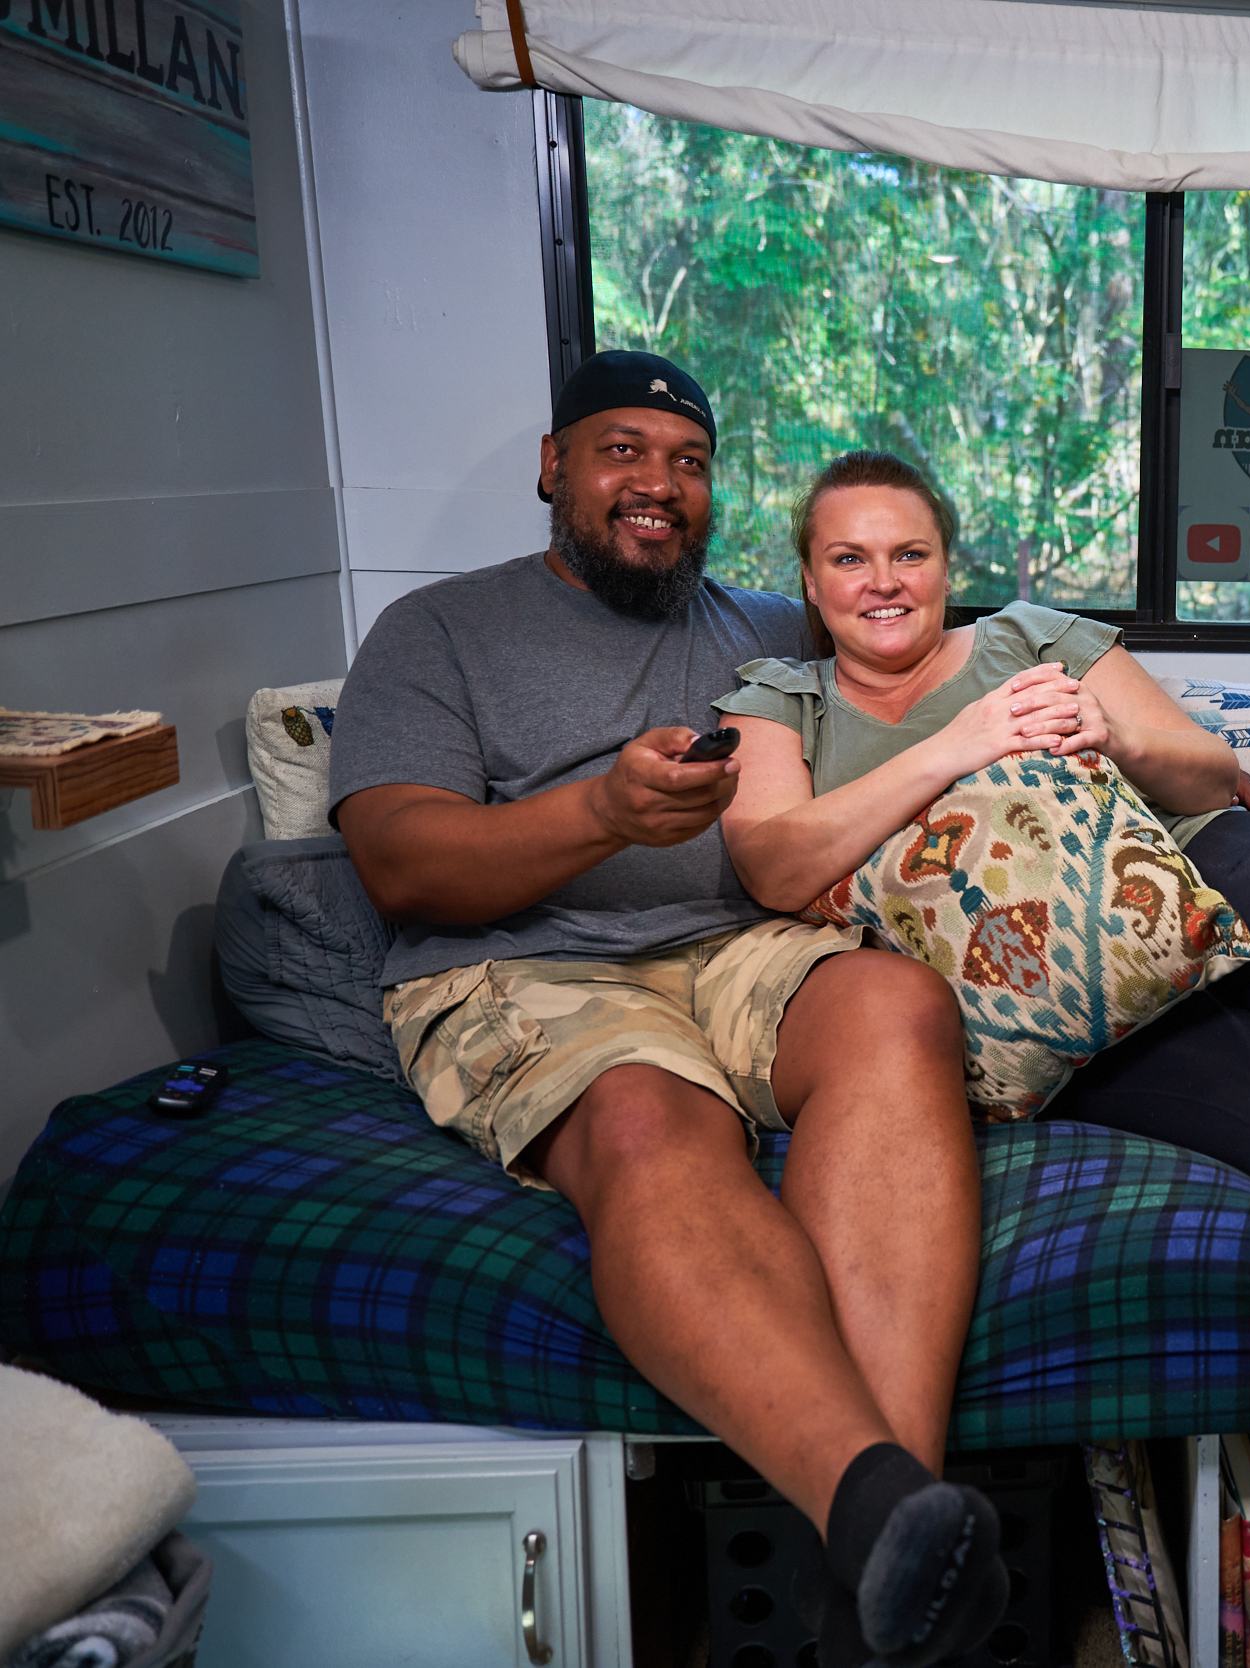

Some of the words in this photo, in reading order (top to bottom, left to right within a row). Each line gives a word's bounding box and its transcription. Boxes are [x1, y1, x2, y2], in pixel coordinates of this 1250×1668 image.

[0, 0, 245, 120] MILLAN
[46, 173, 102, 236] EST.
[119, 198, 174, 252] 2012
